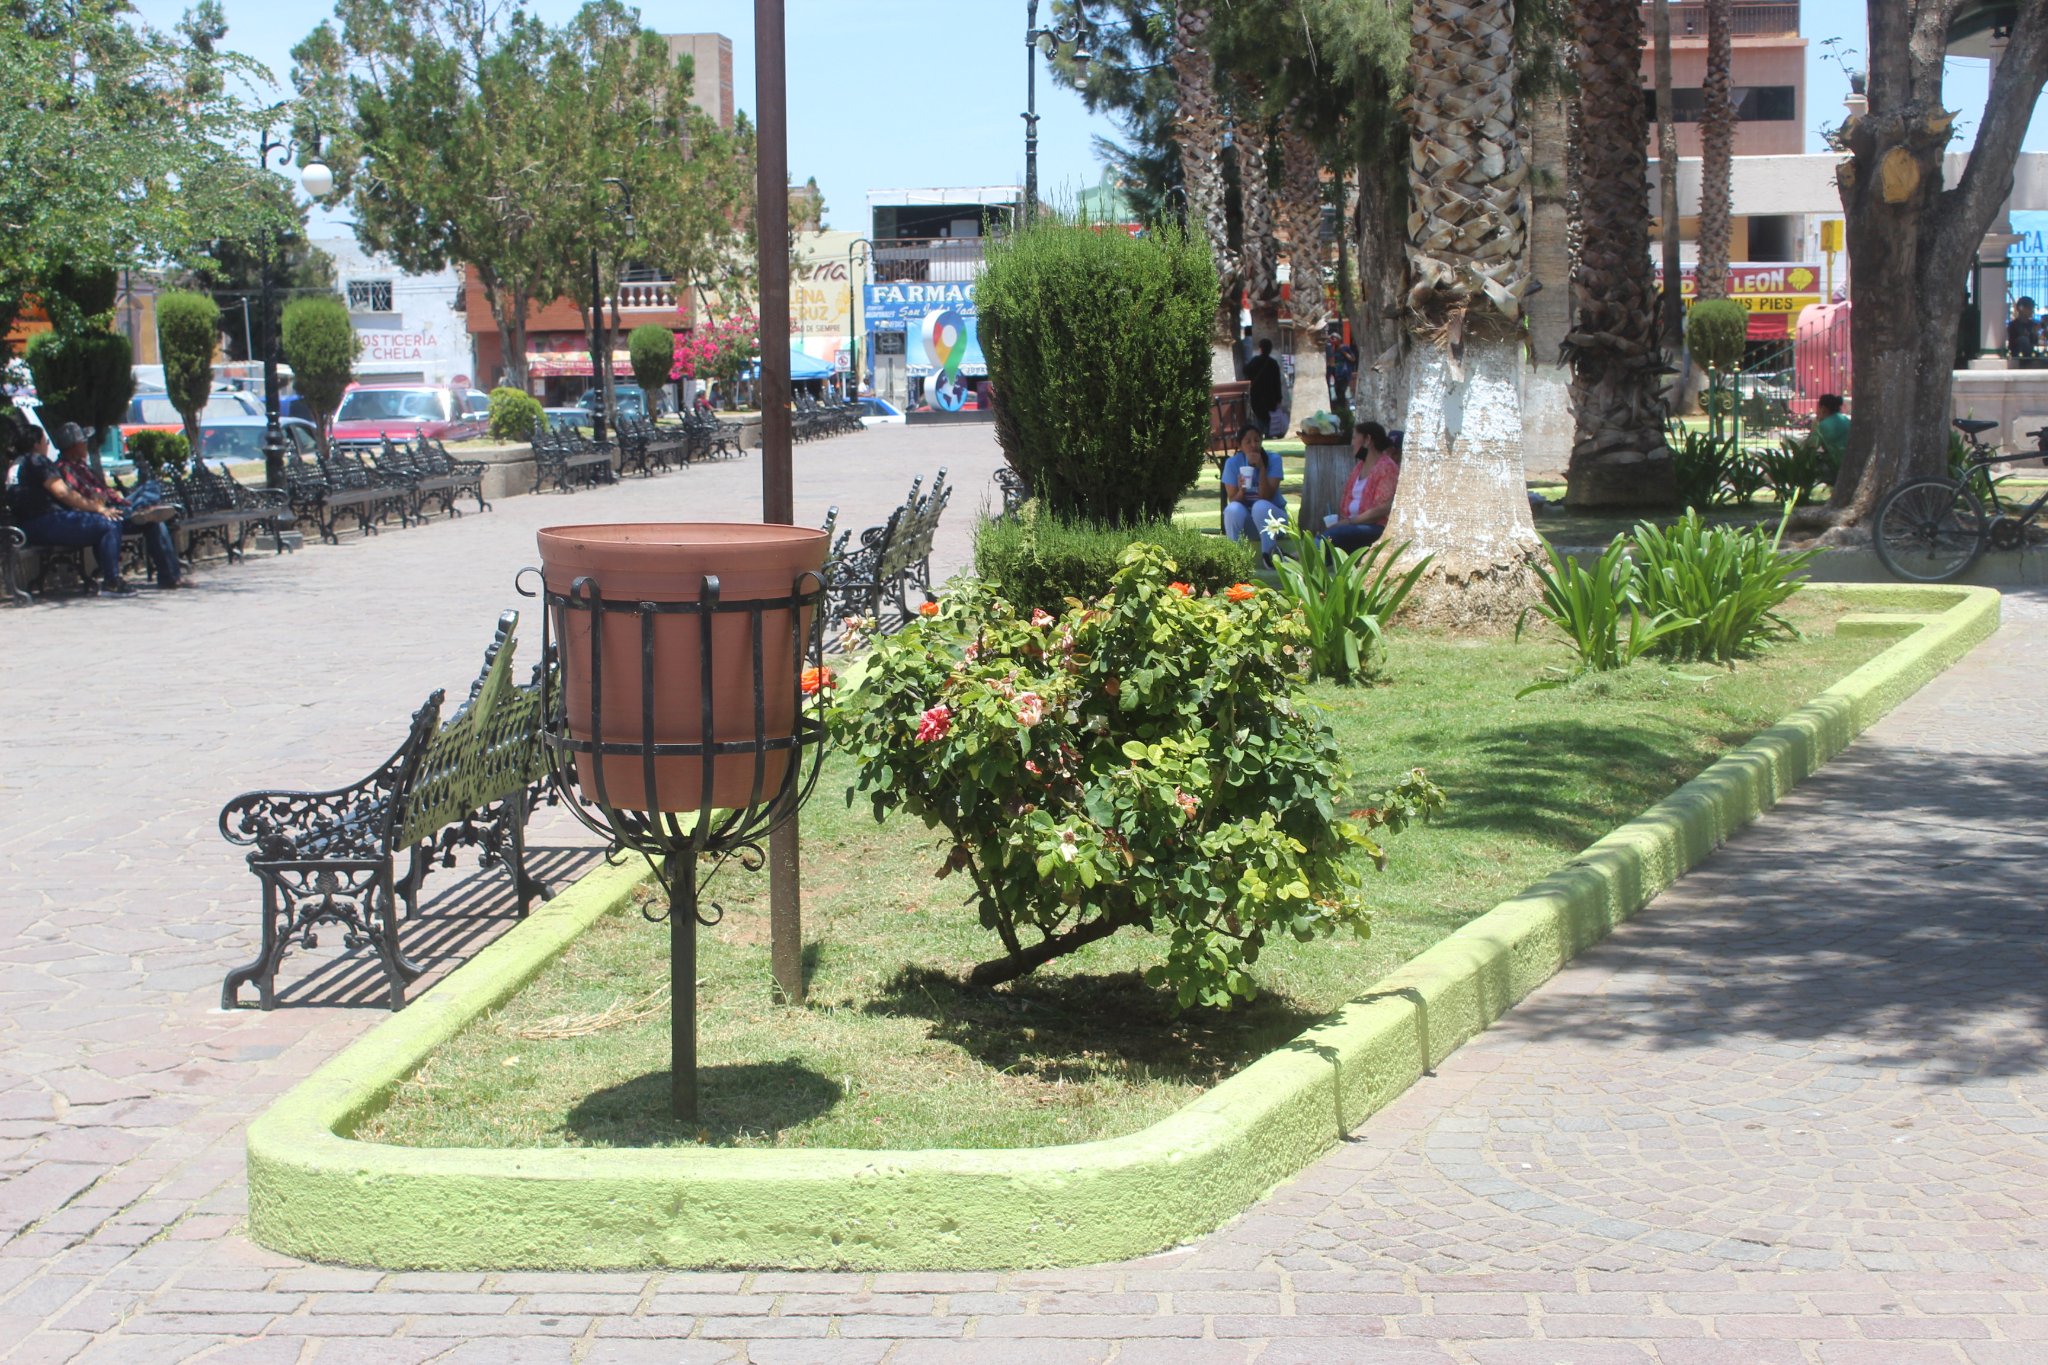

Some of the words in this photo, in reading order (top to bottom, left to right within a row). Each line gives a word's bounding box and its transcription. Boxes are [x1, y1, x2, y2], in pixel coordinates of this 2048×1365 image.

[2009, 230, 2044, 253] ICA
[1734, 269, 1785, 293] LEON
[872, 284, 976, 304] FARMAC
[1760, 298, 1793, 311] PIES
[362, 333, 437, 347] OSTICERIA
[372, 348, 422, 359] CHELA
